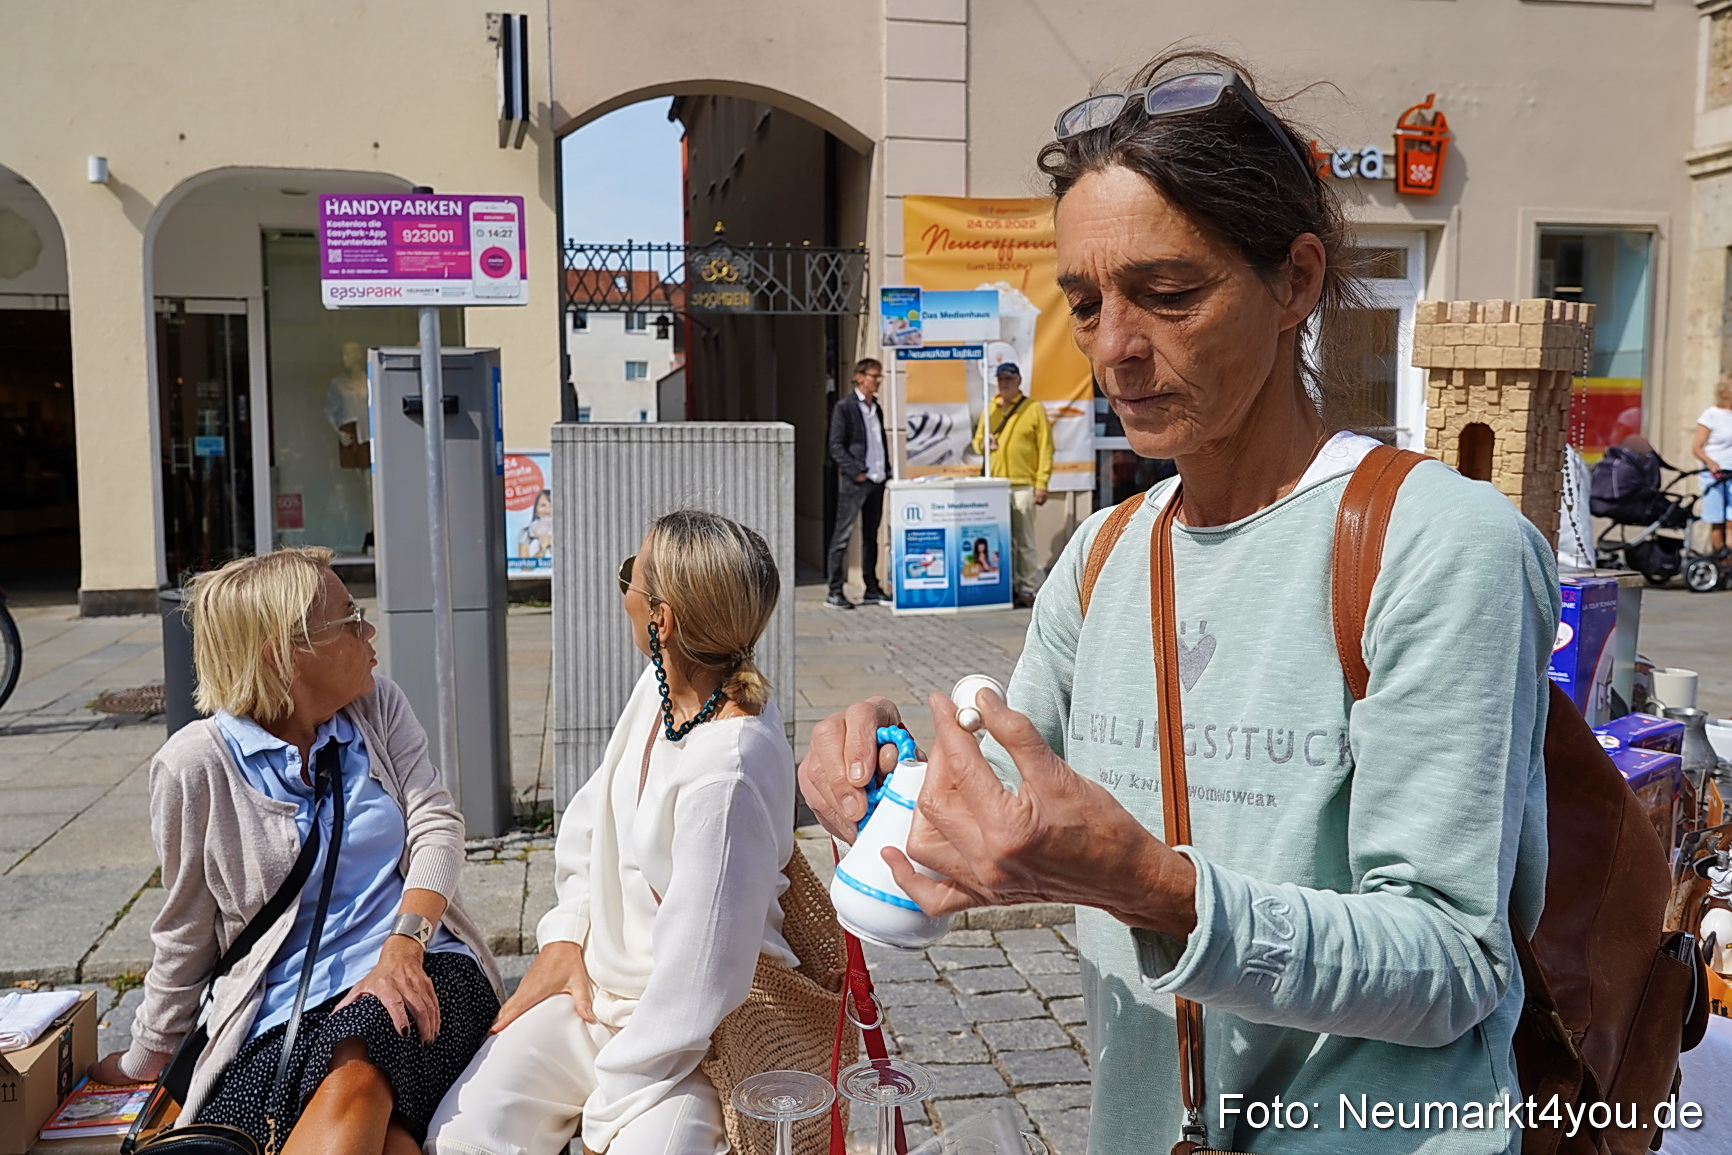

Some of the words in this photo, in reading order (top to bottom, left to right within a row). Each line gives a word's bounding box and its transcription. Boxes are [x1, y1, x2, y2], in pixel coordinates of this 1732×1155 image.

[325, 198, 463, 216] HANDYPARKEN
[326, 220, 367, 229] Kostenlos
[368, 219, 382, 228] die
[966, 219, 1038, 230] 24.05.2022
[326, 229, 387, 239] EasyPark-App
[402, 229, 454, 243] 923001
[487, 229, 514, 238] 14:27
[327, 238, 388, 246] herunterladen
[921, 223, 1057, 262] Neueröffnun
[922, 312, 938, 320] Das
[940, 310, 991, 319] Medienhaus
